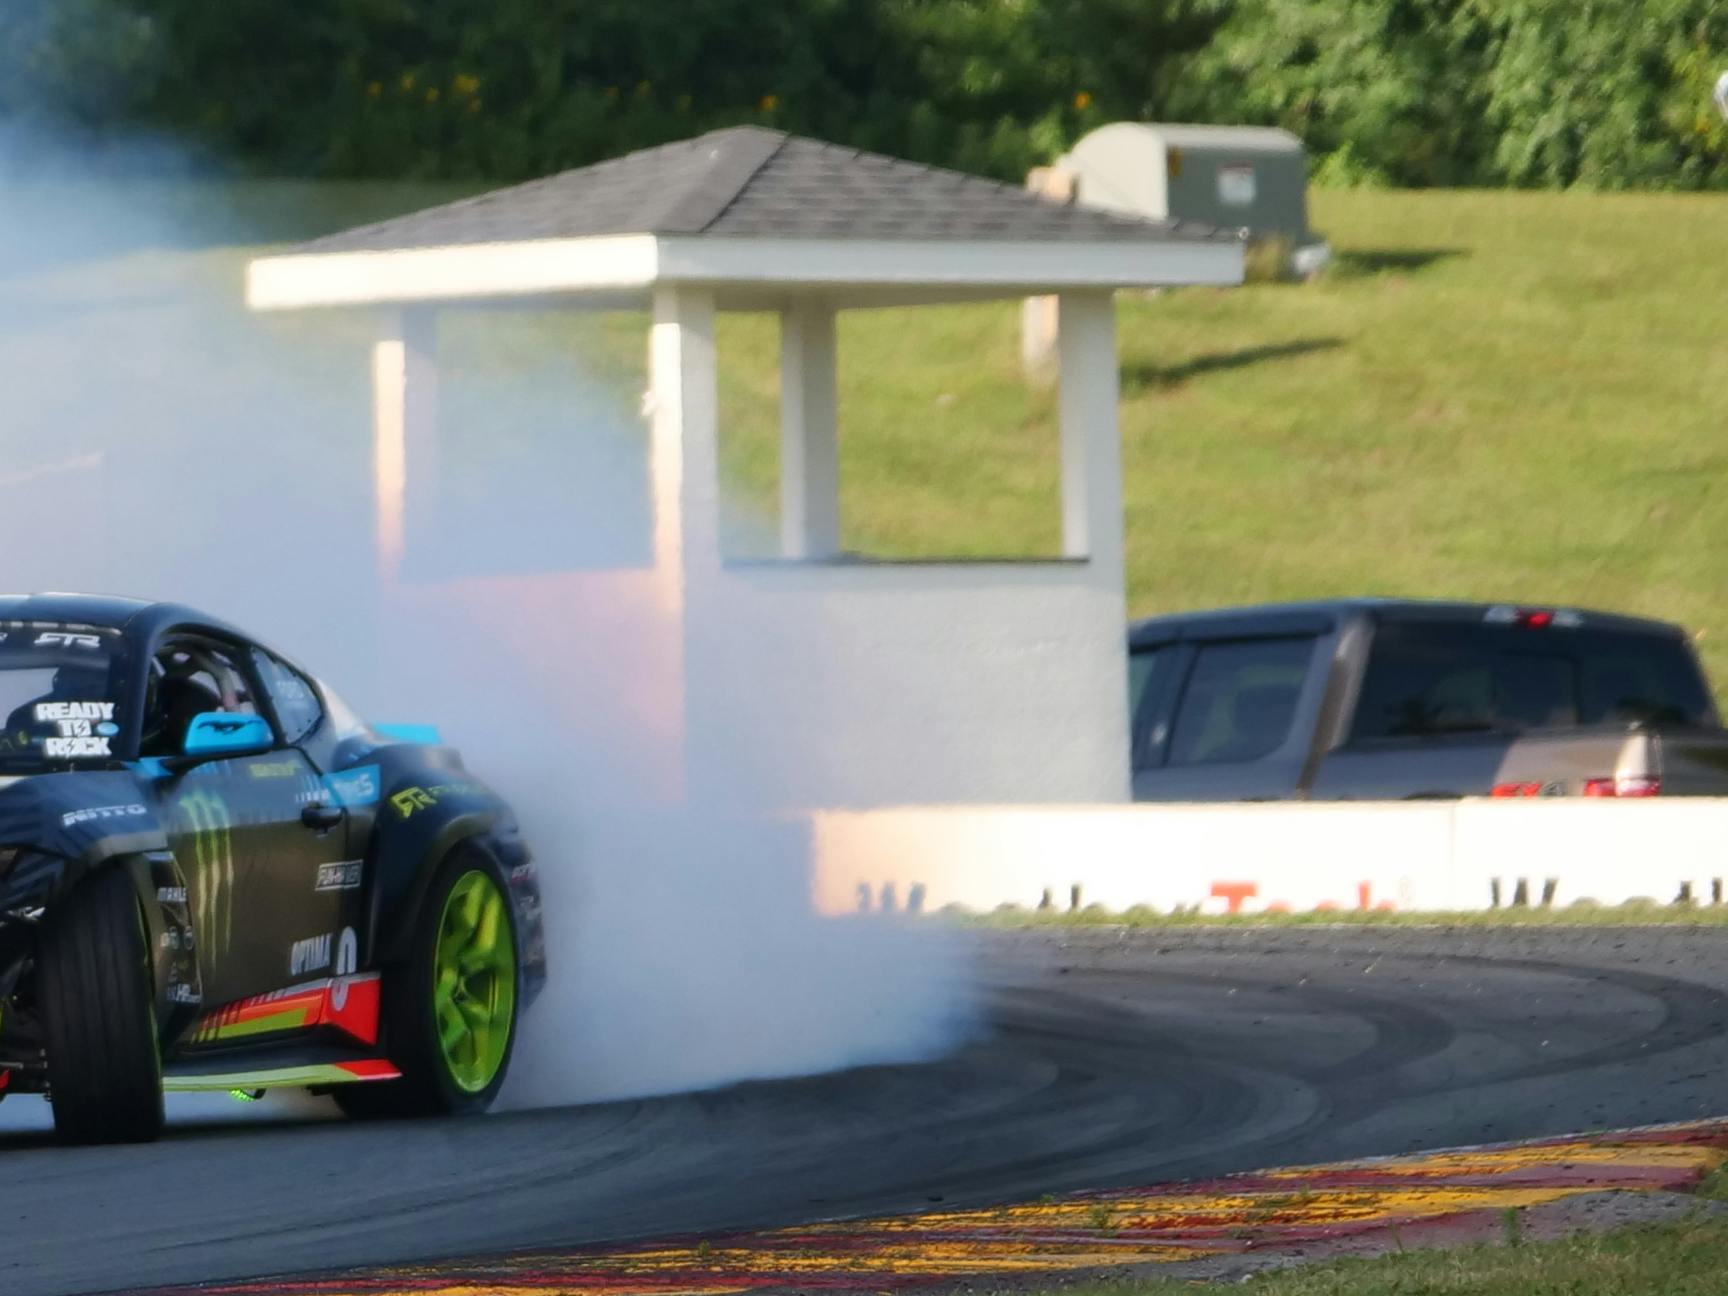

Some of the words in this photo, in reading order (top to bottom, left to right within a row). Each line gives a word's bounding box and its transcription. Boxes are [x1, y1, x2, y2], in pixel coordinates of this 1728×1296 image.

[36, 702, 114, 720] READY
[59, 719, 91, 736] TO
[46, 737, 112, 756] ROCK
[63, 804, 146, 827] NITTO
